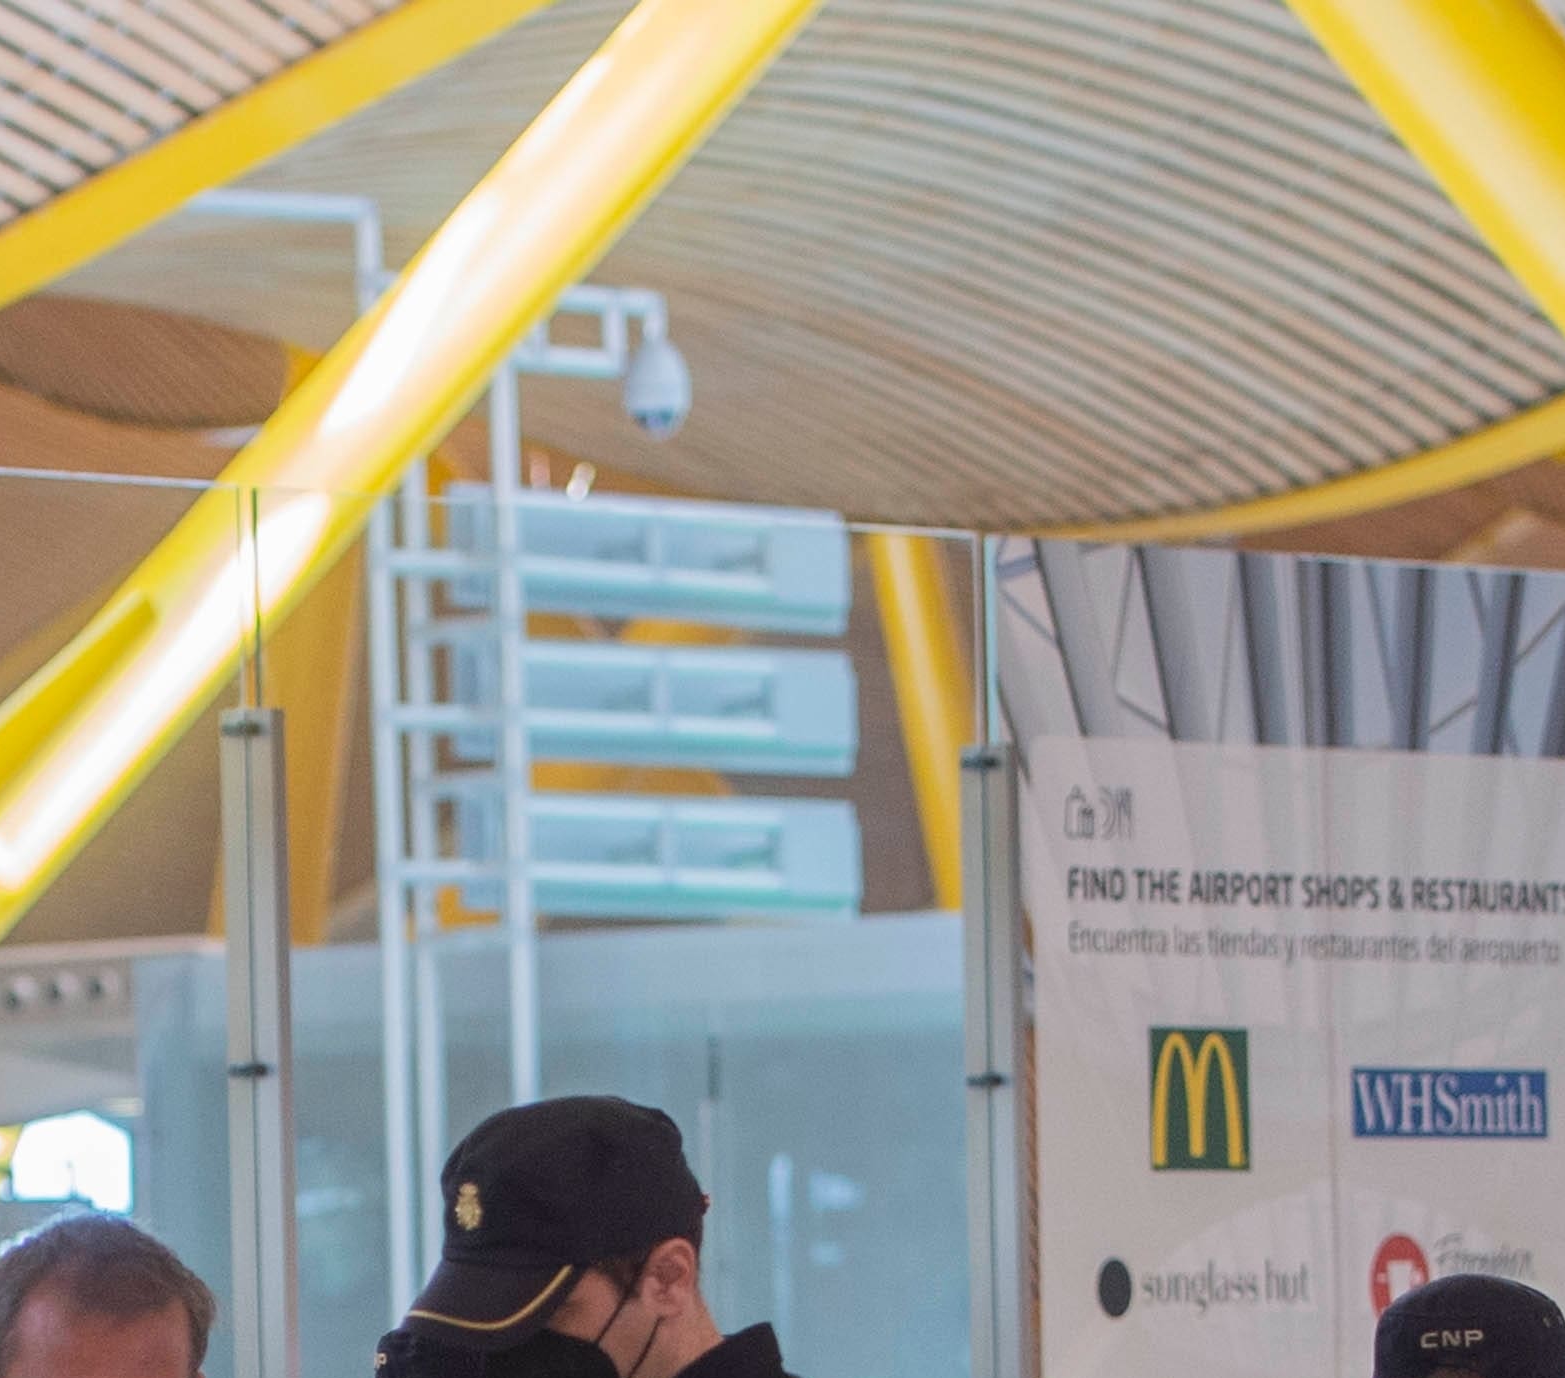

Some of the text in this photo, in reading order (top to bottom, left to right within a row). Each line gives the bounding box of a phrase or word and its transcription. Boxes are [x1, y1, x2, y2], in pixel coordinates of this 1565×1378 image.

[1068, 866, 1126, 903] FIND
[1132, 867, 1182, 904] THE
[1188, 870, 1295, 908] AIRPORT
[1301, 874, 1380, 911] SHOPS
[1387, 876, 1405, 911] &
[1069, 921, 1167, 955] Encuentra
[1173, 923, 1203, 957] las
[1354, 1070, 1543, 1136] WHSmith
[1141, 1258, 1310, 1315] sunglass hut
[1420, 1329, 1485, 1349] CNP
